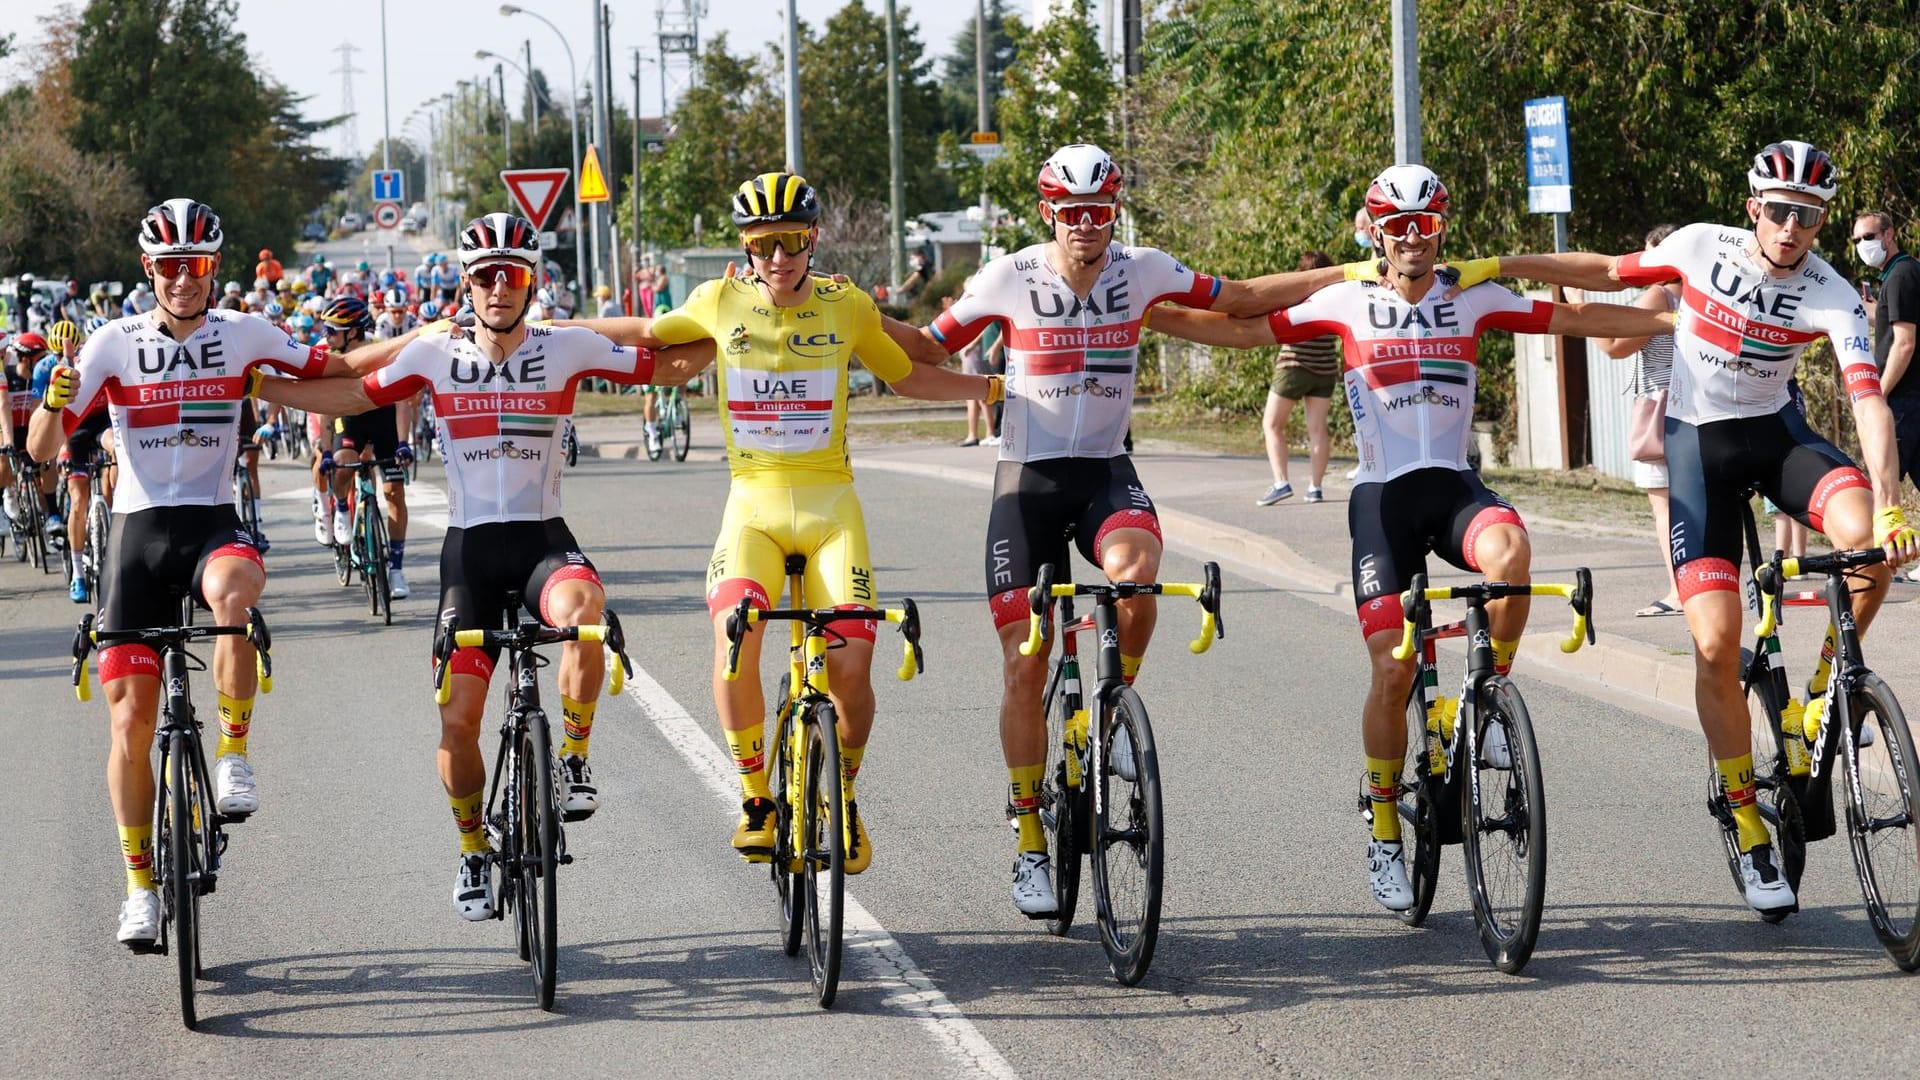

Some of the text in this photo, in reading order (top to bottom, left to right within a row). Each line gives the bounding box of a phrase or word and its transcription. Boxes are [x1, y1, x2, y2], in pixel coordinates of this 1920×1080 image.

[1719, 232, 1744, 247] UAE
[1015, 258, 1039, 271] UAE
[1112, 251, 1132, 262] UAE
[1803, 268, 1829, 285] UAE
[1030, 280, 1130, 318] UAE
[1710, 261, 1803, 320] UAE
[208, 314, 227, 323] UAE
[752, 305, 771, 317] LCL
[796, 310, 818, 319] LCL
[1036, 312, 1130, 326] TEAM
[1369, 302, 1458, 329] UAE
[122, 322, 145, 334] UAE
[1704, 299, 1789, 343] Emirates
[532, 328, 552, 337] UAE
[792, 333, 845, 346] LCL
[1037, 329, 1129, 347] Emirates
[1373, 328, 1460, 337] TEAM
[1373, 342, 1461, 359] Emirates
[1844, 335, 1870, 352] FAB
[138, 340, 225, 374] UAE
[1699, 350, 1778, 379] WHOOSH
[140, 368, 226, 383] TEAM
[451, 355, 546, 383] UAE
[139, 383, 225, 402] Emirates
[452, 383, 546, 392] TEAM
[753, 379, 807, 394] UAE
[1038, 384, 1122, 399] WHOOSH
[452, 395, 546, 412] Emirates
[754, 402, 806, 410] Emirates
[1384, 393, 1460, 412] WHOOSH
[139, 435, 220, 449] WHOOSH
[463, 447, 541, 462] WHOOSH
[1671, 521, 1686, 565] UAE
[709, 548, 727, 583] UAE
[993, 539, 1012, 586] UAE
[1360, 553, 1381, 595] UAE
[852, 566, 871, 600] UAE
[1470, 737, 1479, 805] COLNAGO
[1847, 737, 1862, 805] COLNAGO
